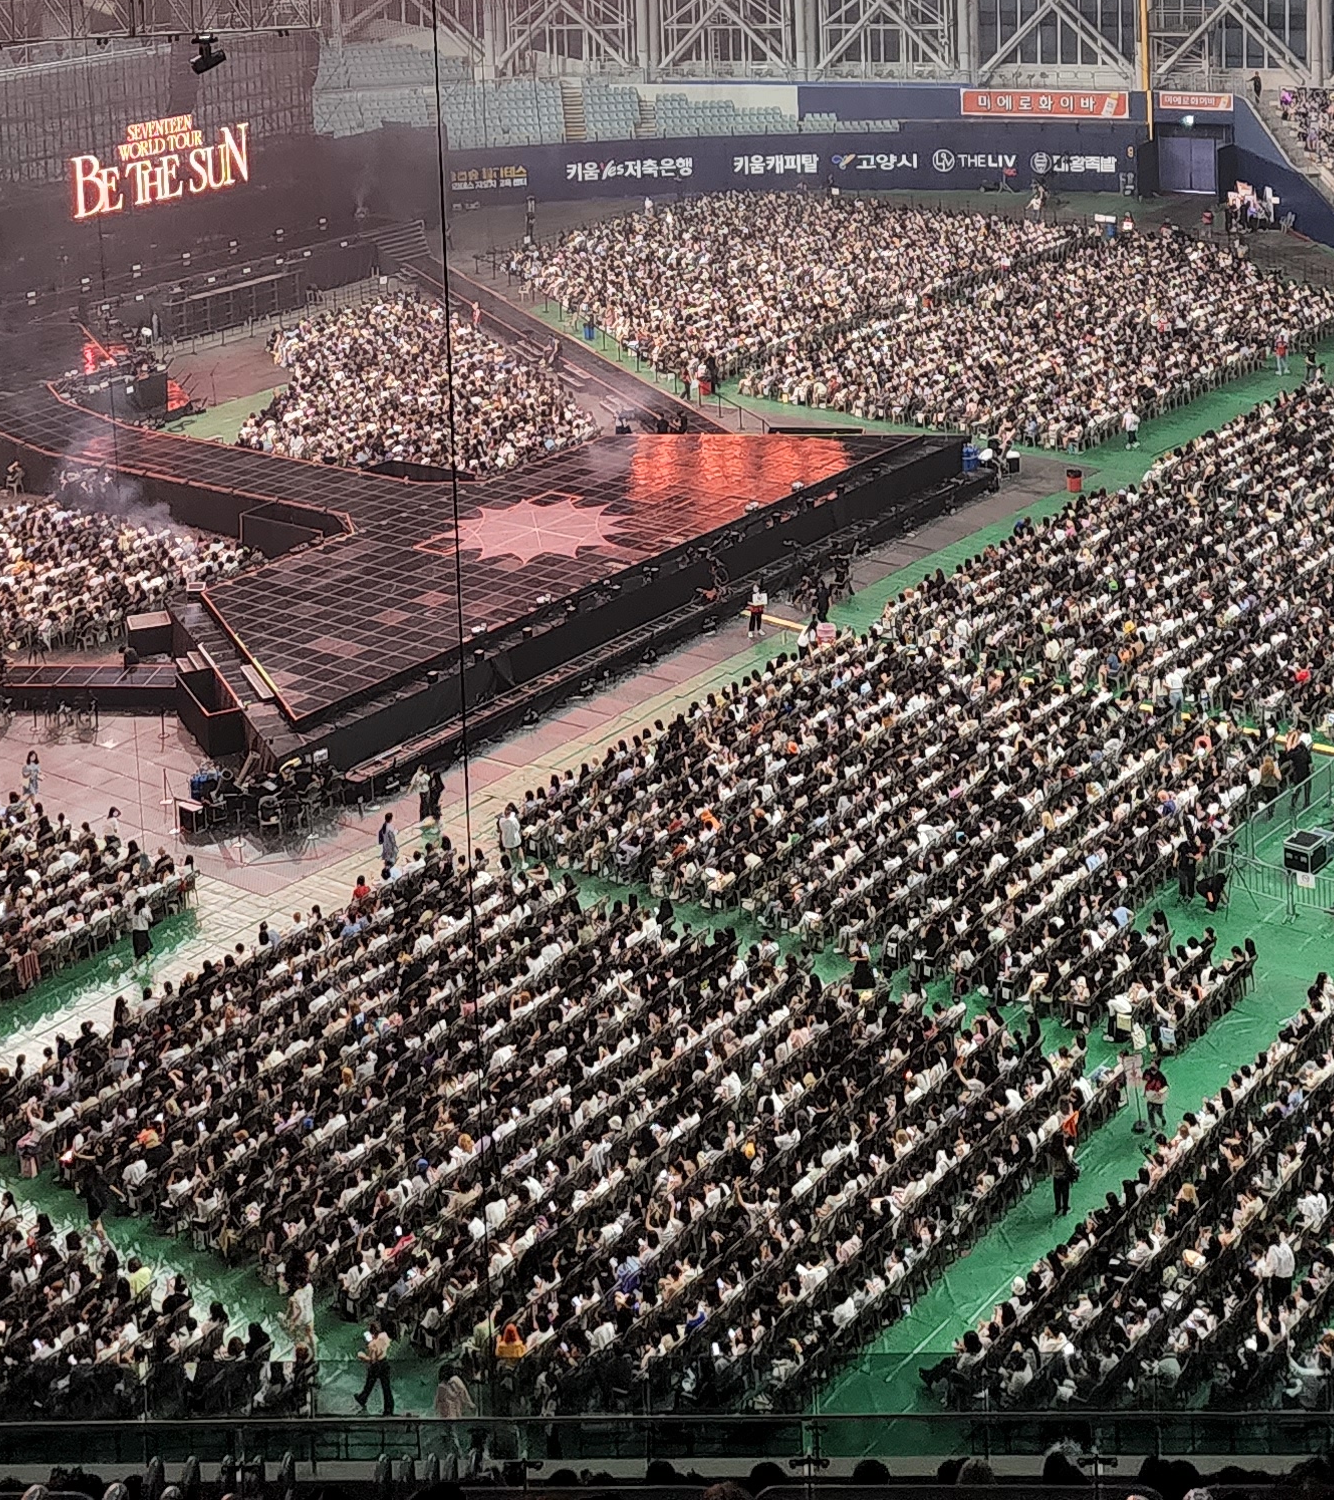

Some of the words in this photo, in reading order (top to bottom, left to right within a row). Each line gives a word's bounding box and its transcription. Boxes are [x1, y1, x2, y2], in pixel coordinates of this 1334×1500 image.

[977, 94, 1097, 112] 미에로화이바
[127, 114, 193, 142] SEVENTEEN
[117, 137, 166, 161] WORLD
[168, 130, 203, 152] TOUR
[70, 155, 123, 219] BE
[125, 154, 183, 205] THE
[189, 122, 249, 194] SUN
[733, 153, 819, 175] 키움캐피탈
[855, 154, 919, 170] 고양시
